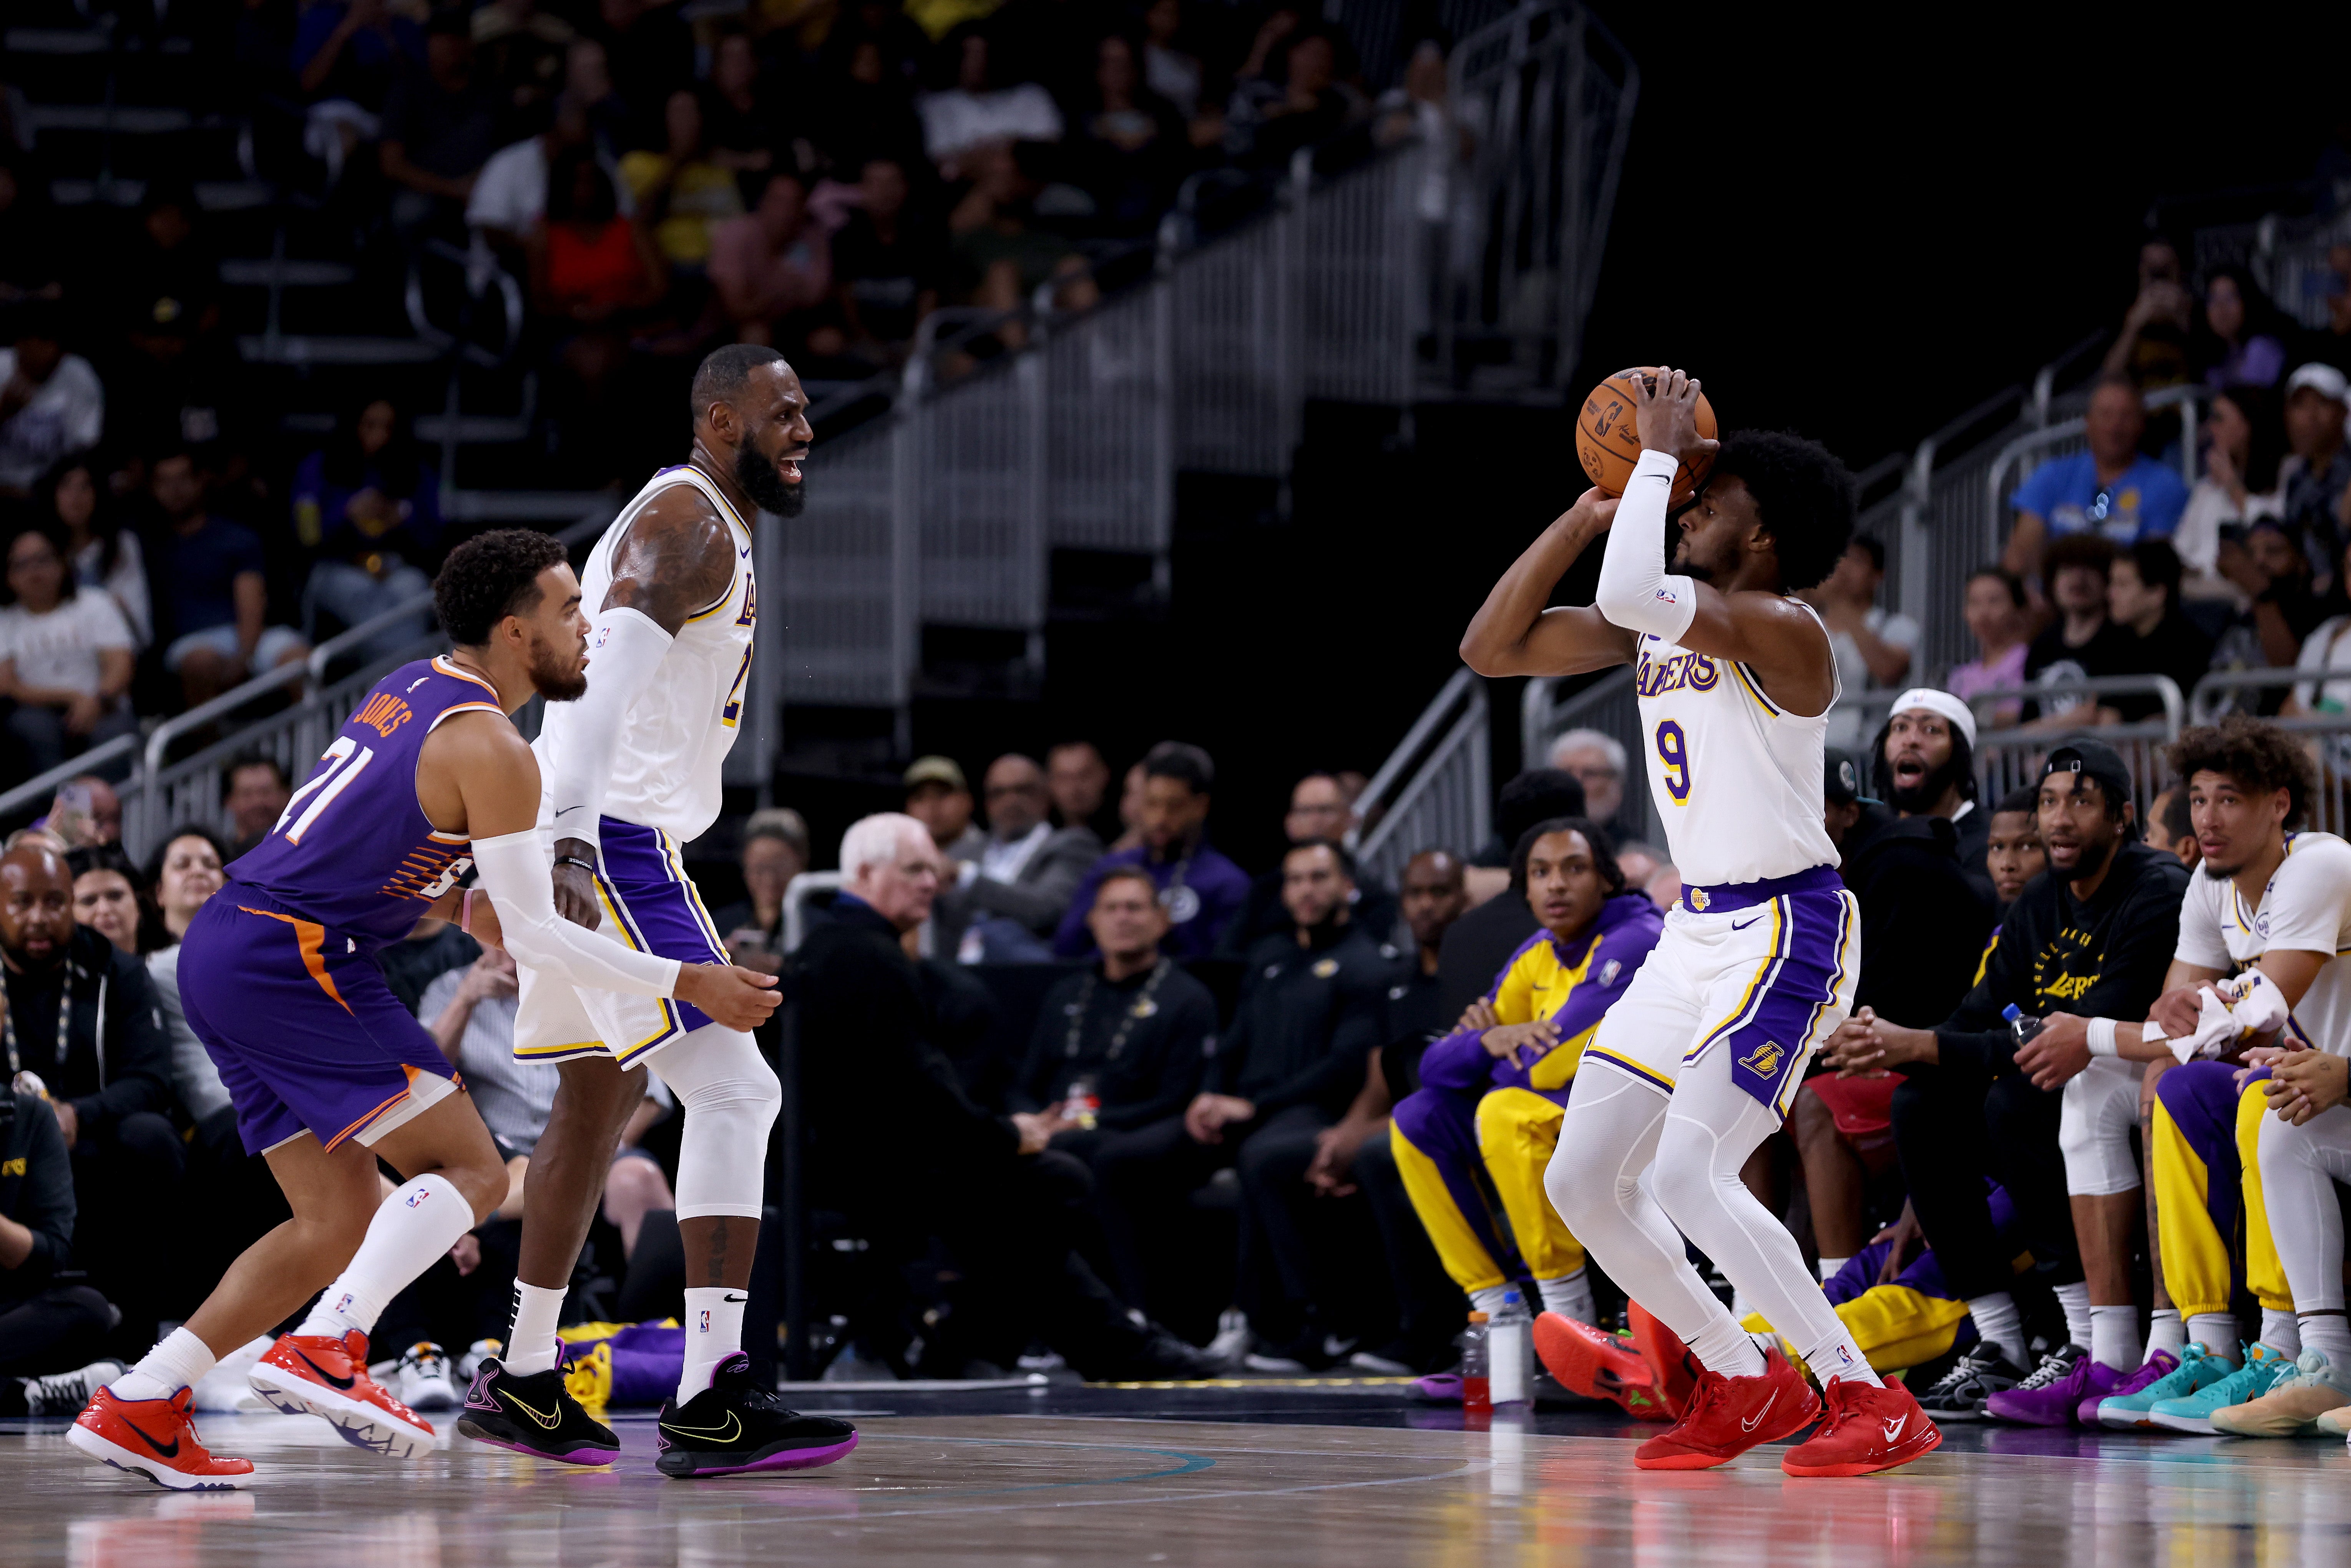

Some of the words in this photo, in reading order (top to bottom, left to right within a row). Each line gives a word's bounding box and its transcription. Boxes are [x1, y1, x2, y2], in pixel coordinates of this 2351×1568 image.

[354, 692, 412, 737] JONES
[272, 736, 374, 845] 21
[1655, 718, 1692, 806] 9
[569, 858, 590, 869] PROMISE
